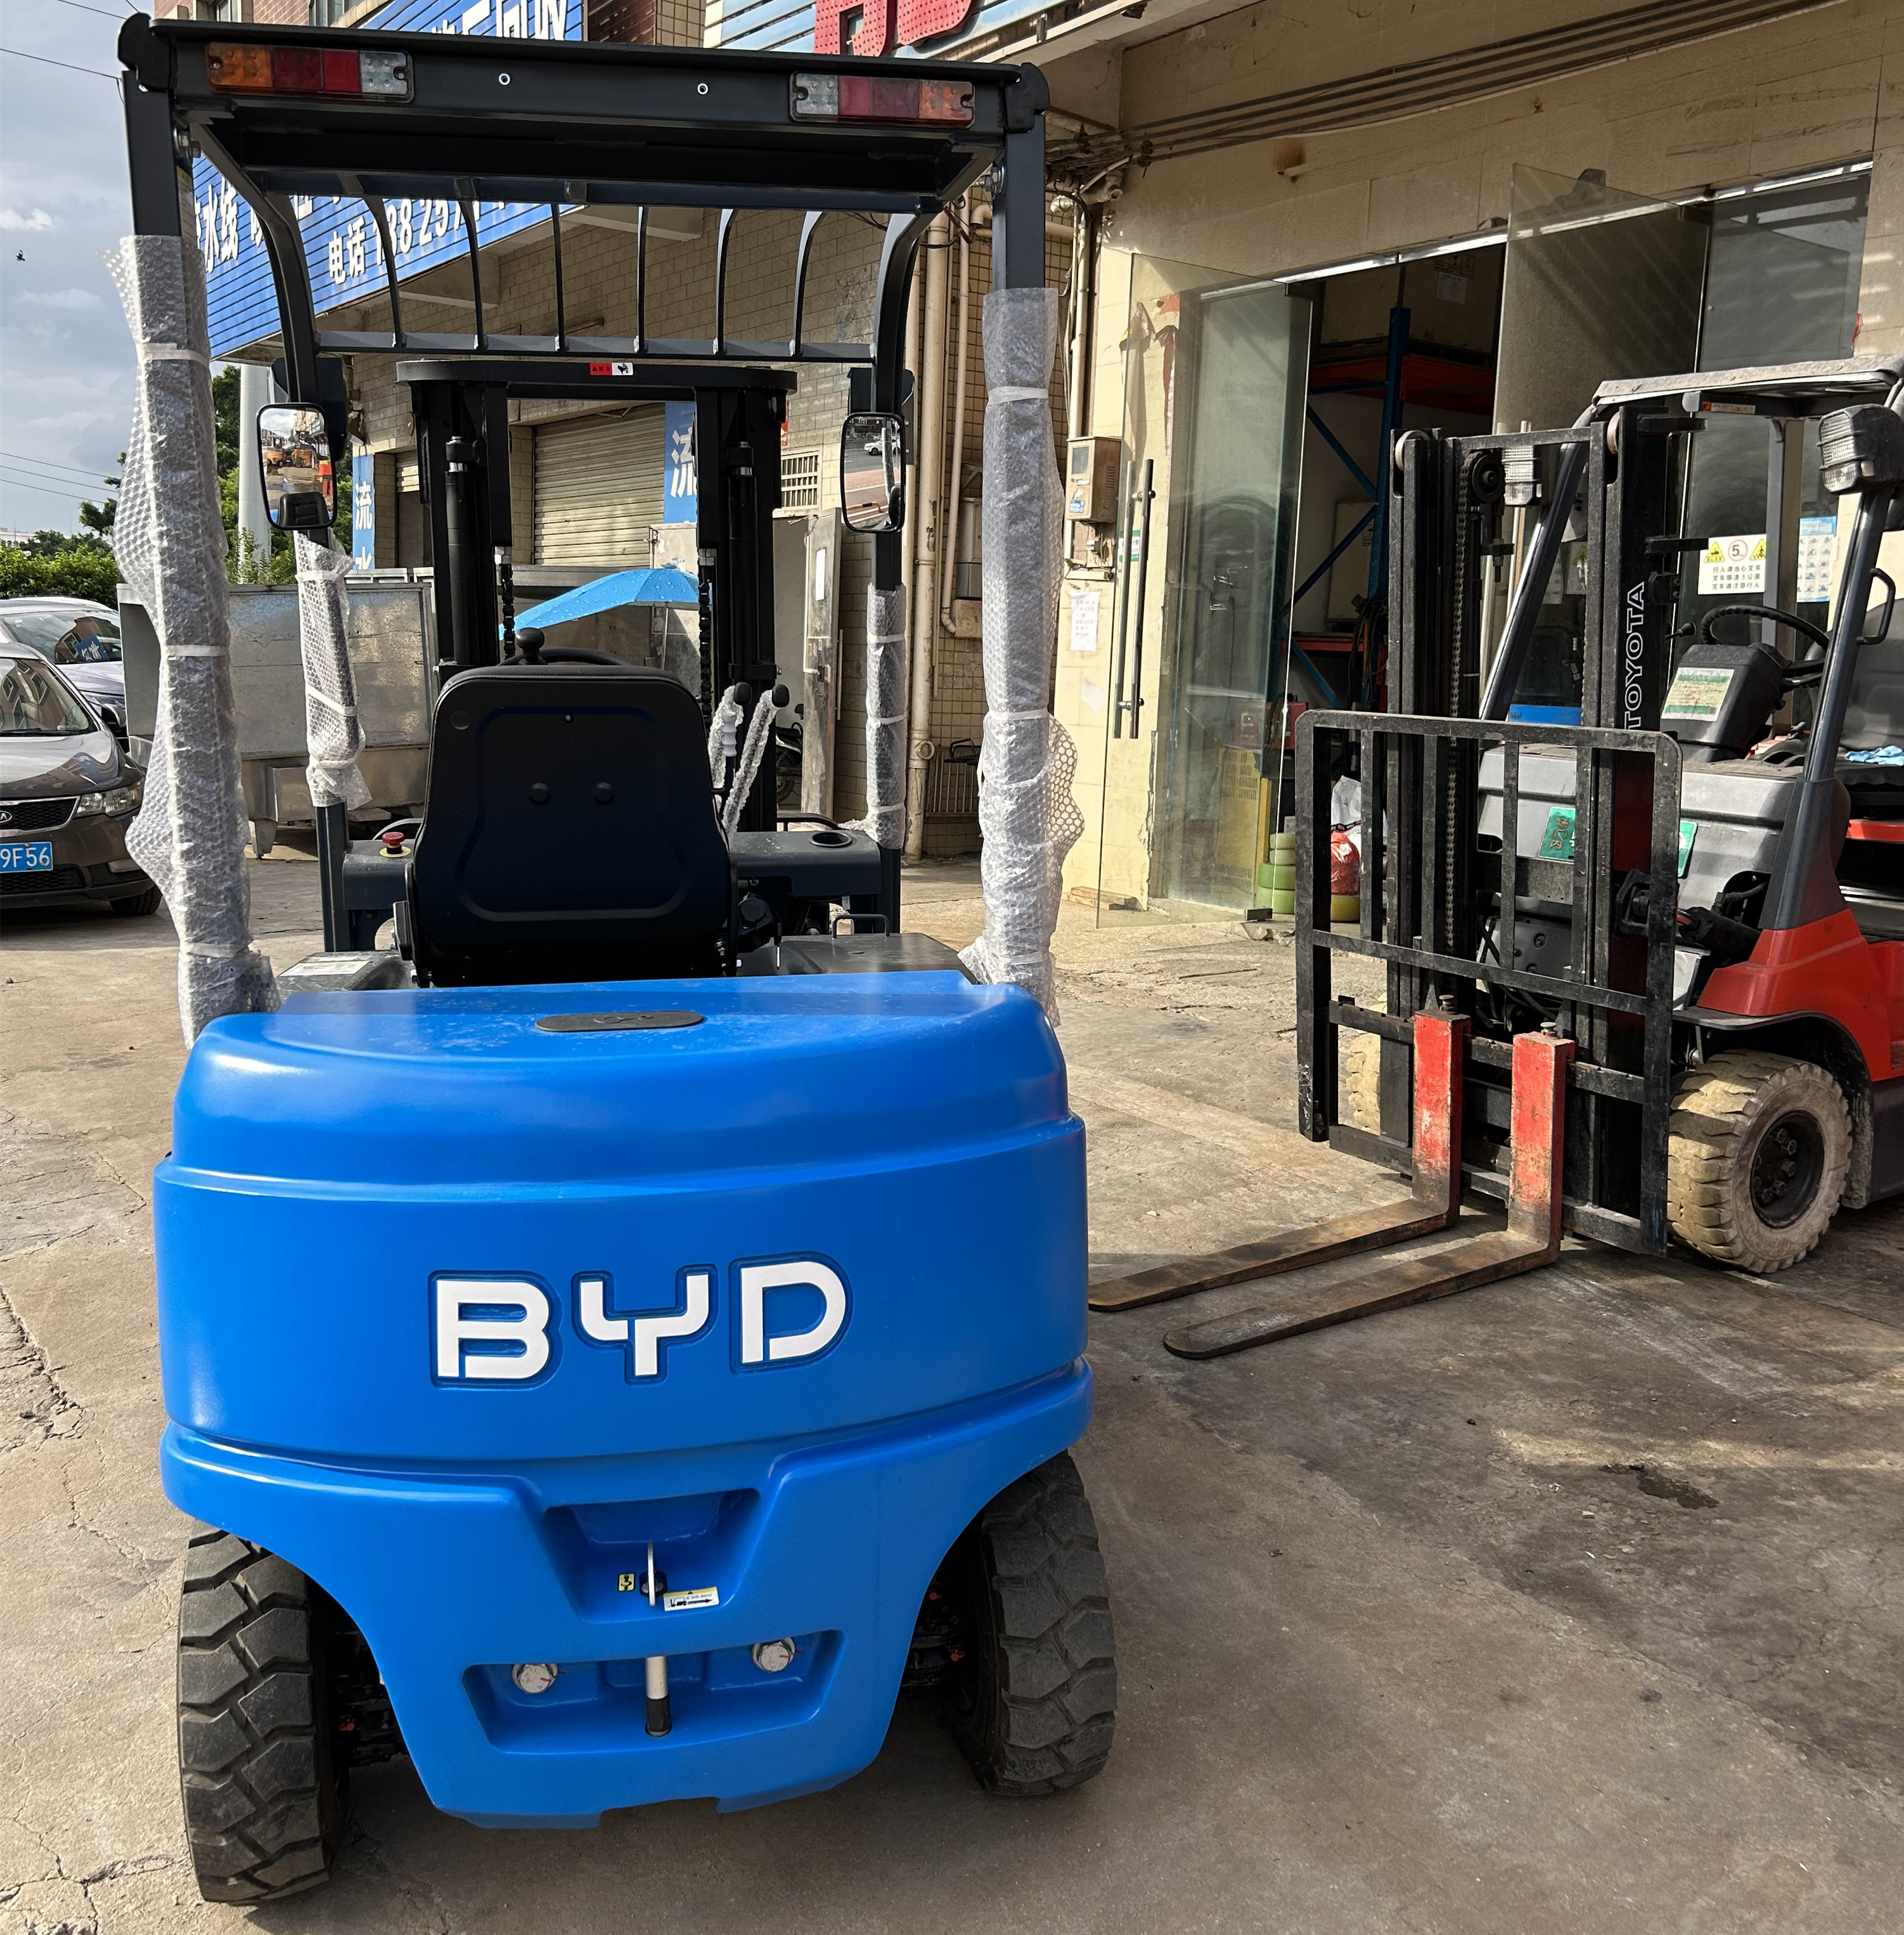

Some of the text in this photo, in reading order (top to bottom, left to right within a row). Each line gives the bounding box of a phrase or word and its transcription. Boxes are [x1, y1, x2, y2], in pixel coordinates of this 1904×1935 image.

[329, 216, 366, 285] 电话
[1732, 544, 1740, 556] 5
[1624, 581, 1645, 730] TOYOTA
[437, 1261, 846, 1380] BYD
